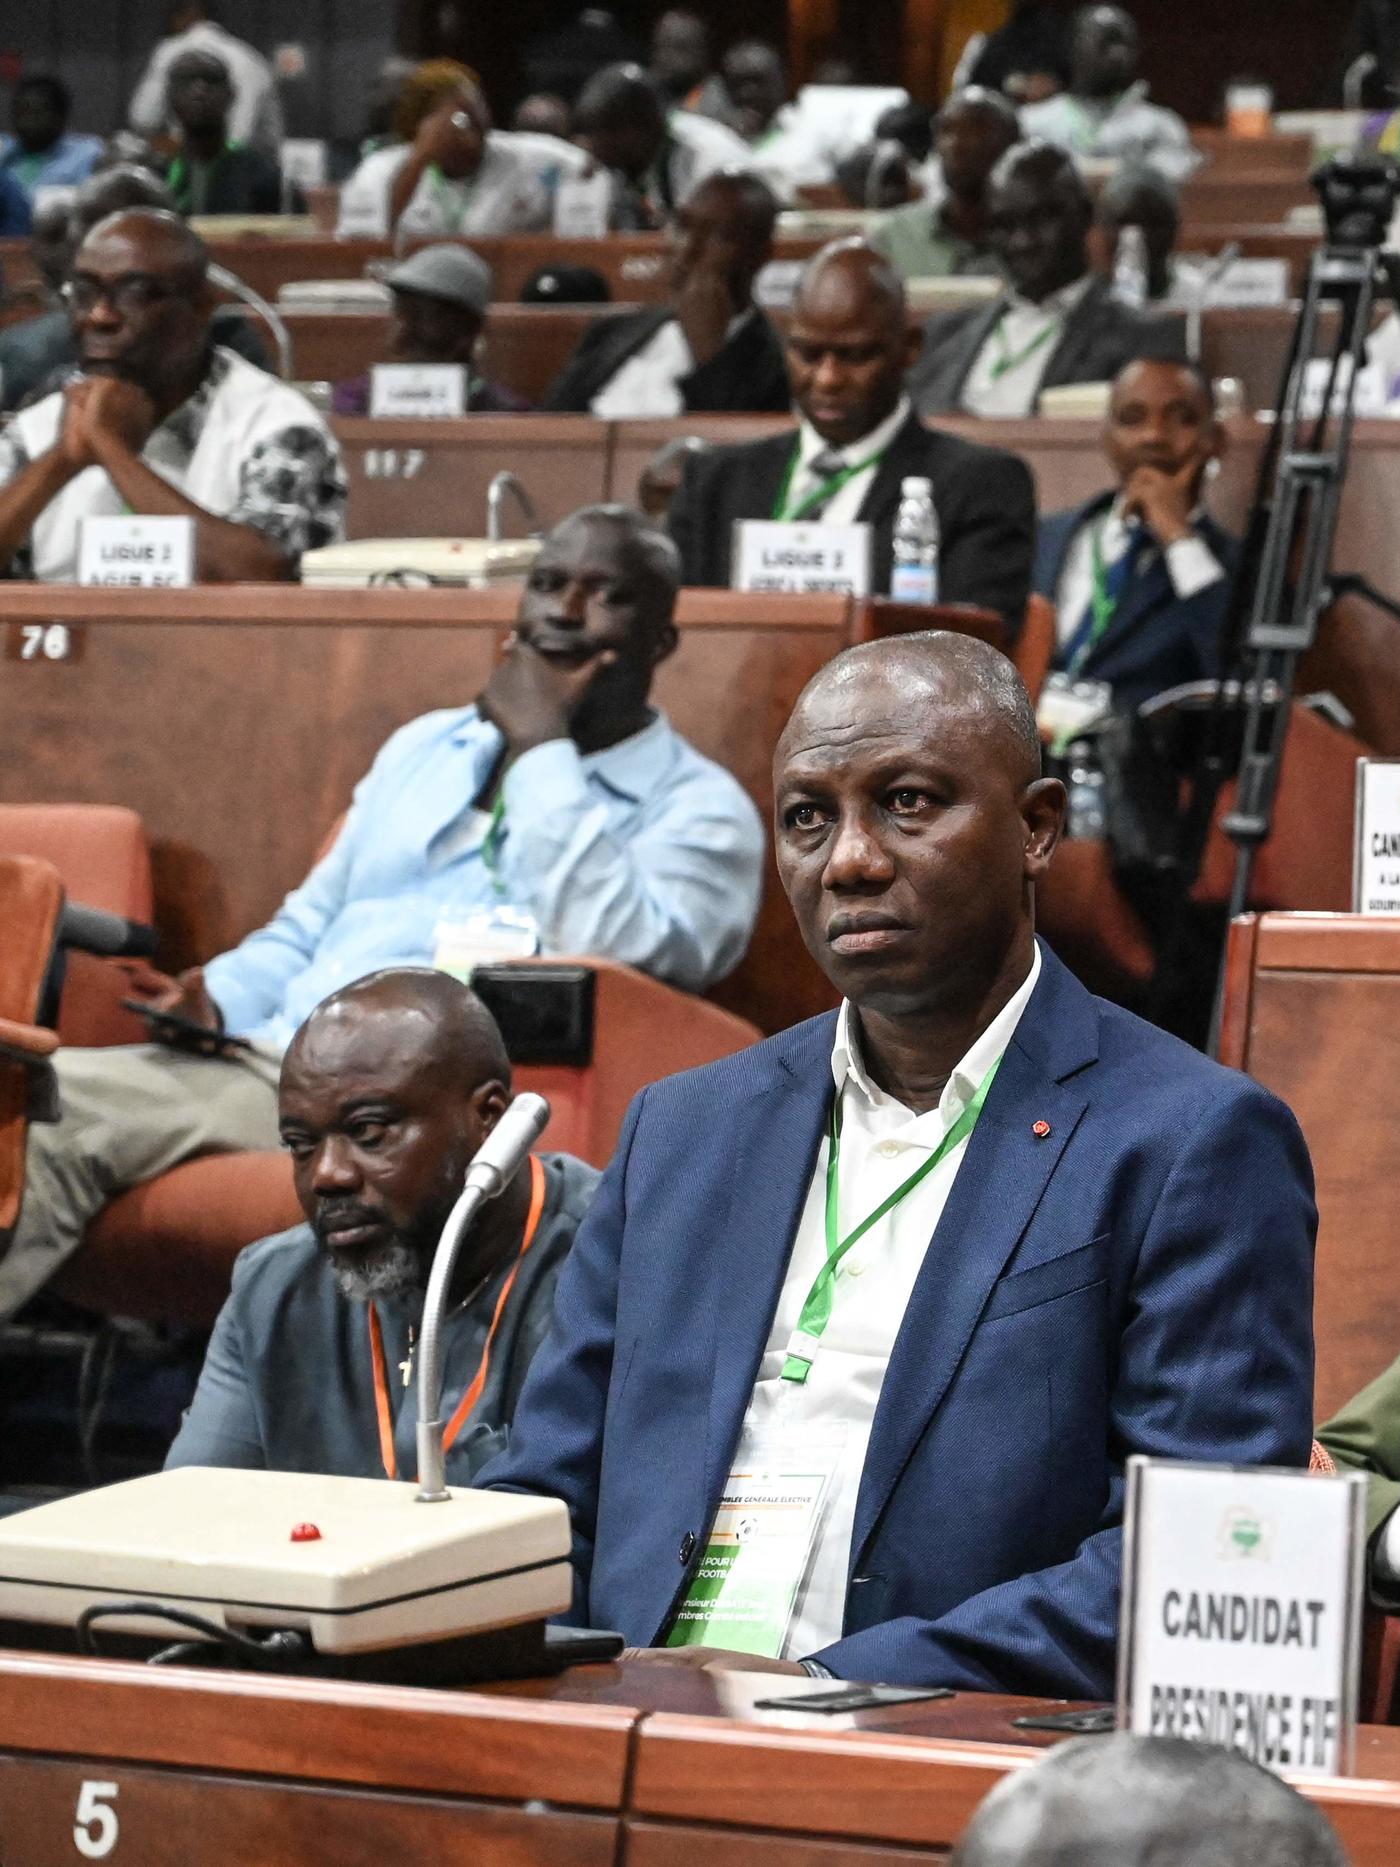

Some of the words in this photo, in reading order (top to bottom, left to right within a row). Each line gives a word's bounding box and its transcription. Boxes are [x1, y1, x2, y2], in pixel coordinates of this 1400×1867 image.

[365, 449, 424, 479] 117
[22, 625, 68, 660] 76
[705, 1557, 730, 1566] POUR
[1163, 1589, 1325, 1649] CANDIDAT
[1152, 1684, 1292, 1764] PRESIDENCE
[1299, 1697, 1338, 1767] FIF
[73, 1780, 120, 1860] 5
